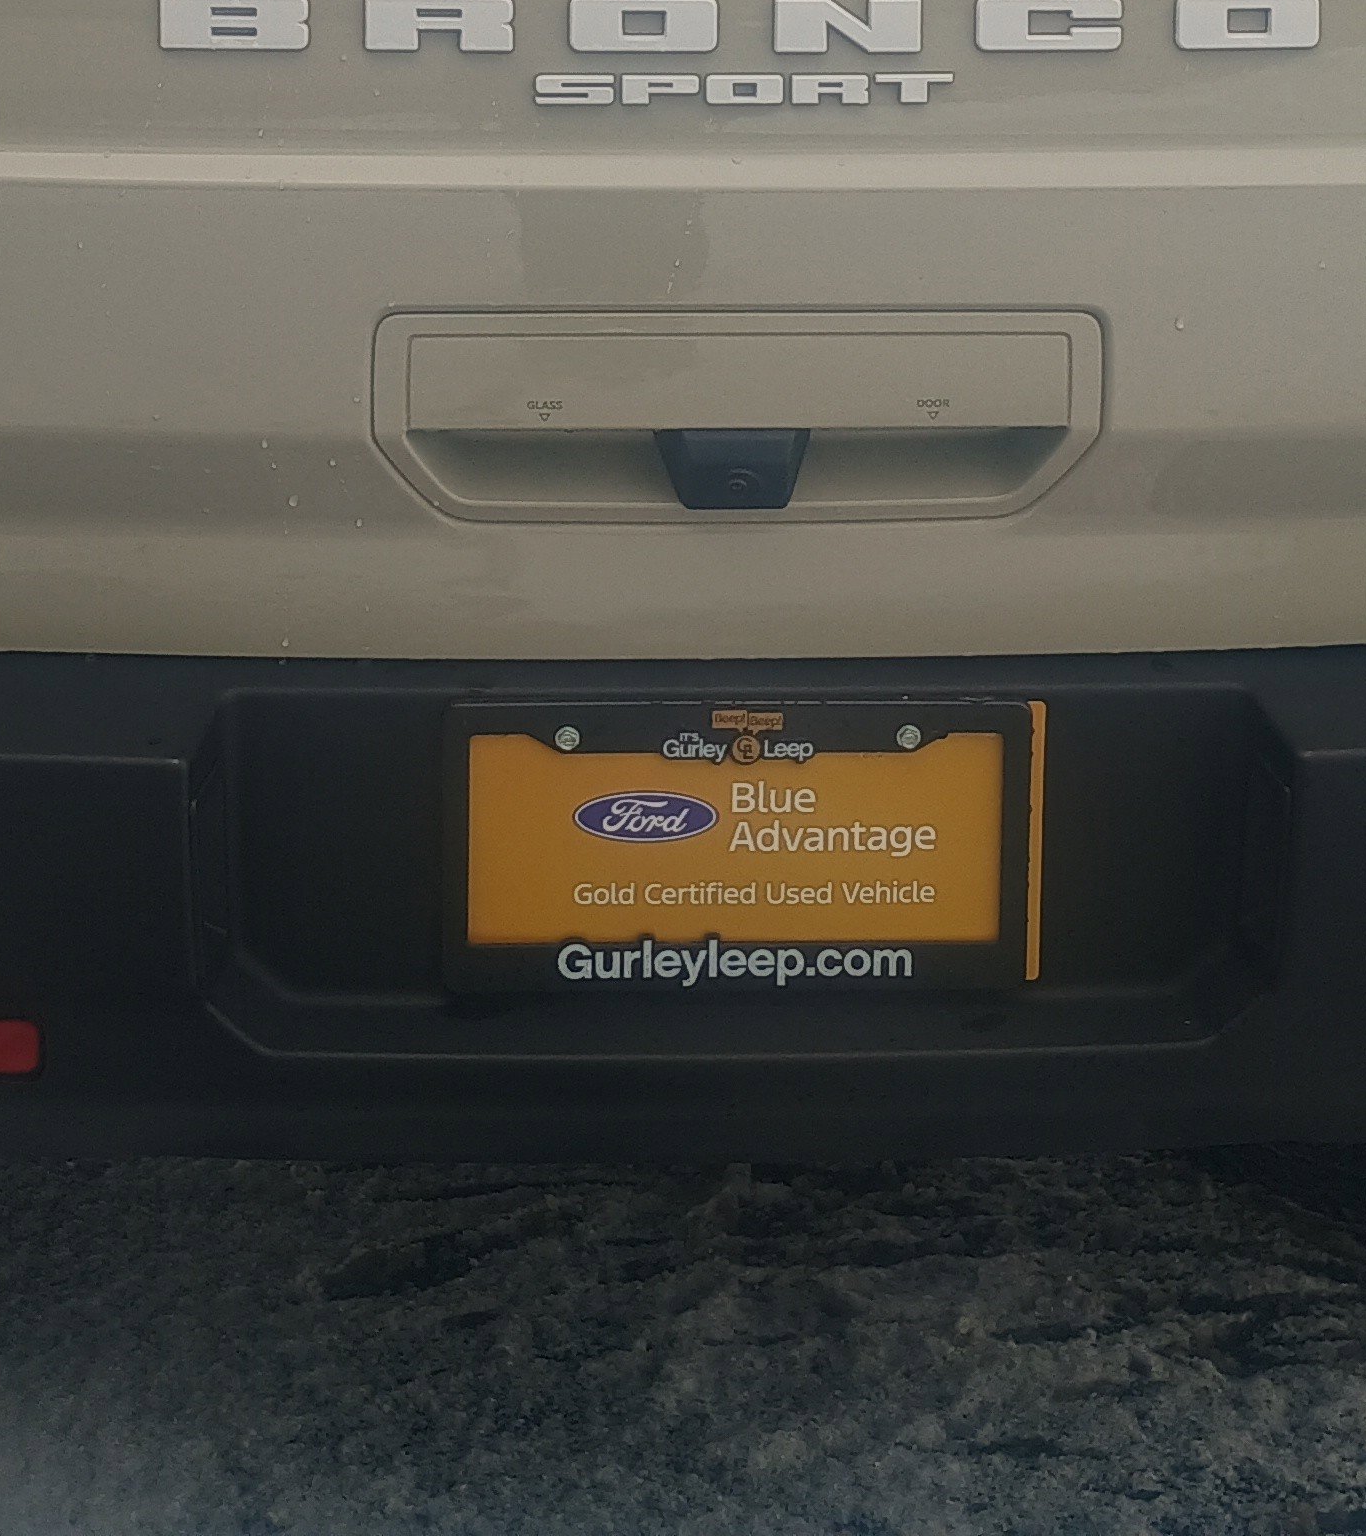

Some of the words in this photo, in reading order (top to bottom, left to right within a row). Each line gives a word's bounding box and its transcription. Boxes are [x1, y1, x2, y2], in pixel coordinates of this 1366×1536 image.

[533, 71, 955, 106] SPORT
[526, 400, 564, 410] GLASS
[916, 399, 950, 408] DOOR
[714, 714, 746, 724] Beep!
[749, 715, 782, 728] Beep!
[662, 738, 727, 762] Gurley
[764, 739, 814, 761] Leep
[731, 781, 816, 813] Blue
[602, 795, 688, 833] Ford
[729, 820, 936, 858] Advantage
[573, 882, 635, 906] Gold
[644, 881, 756, 905] Certified
[766, 882, 832, 905] Used
[841, 880, 935, 904] Vehicle
[557, 939, 913, 988] Gurleyleep.com
